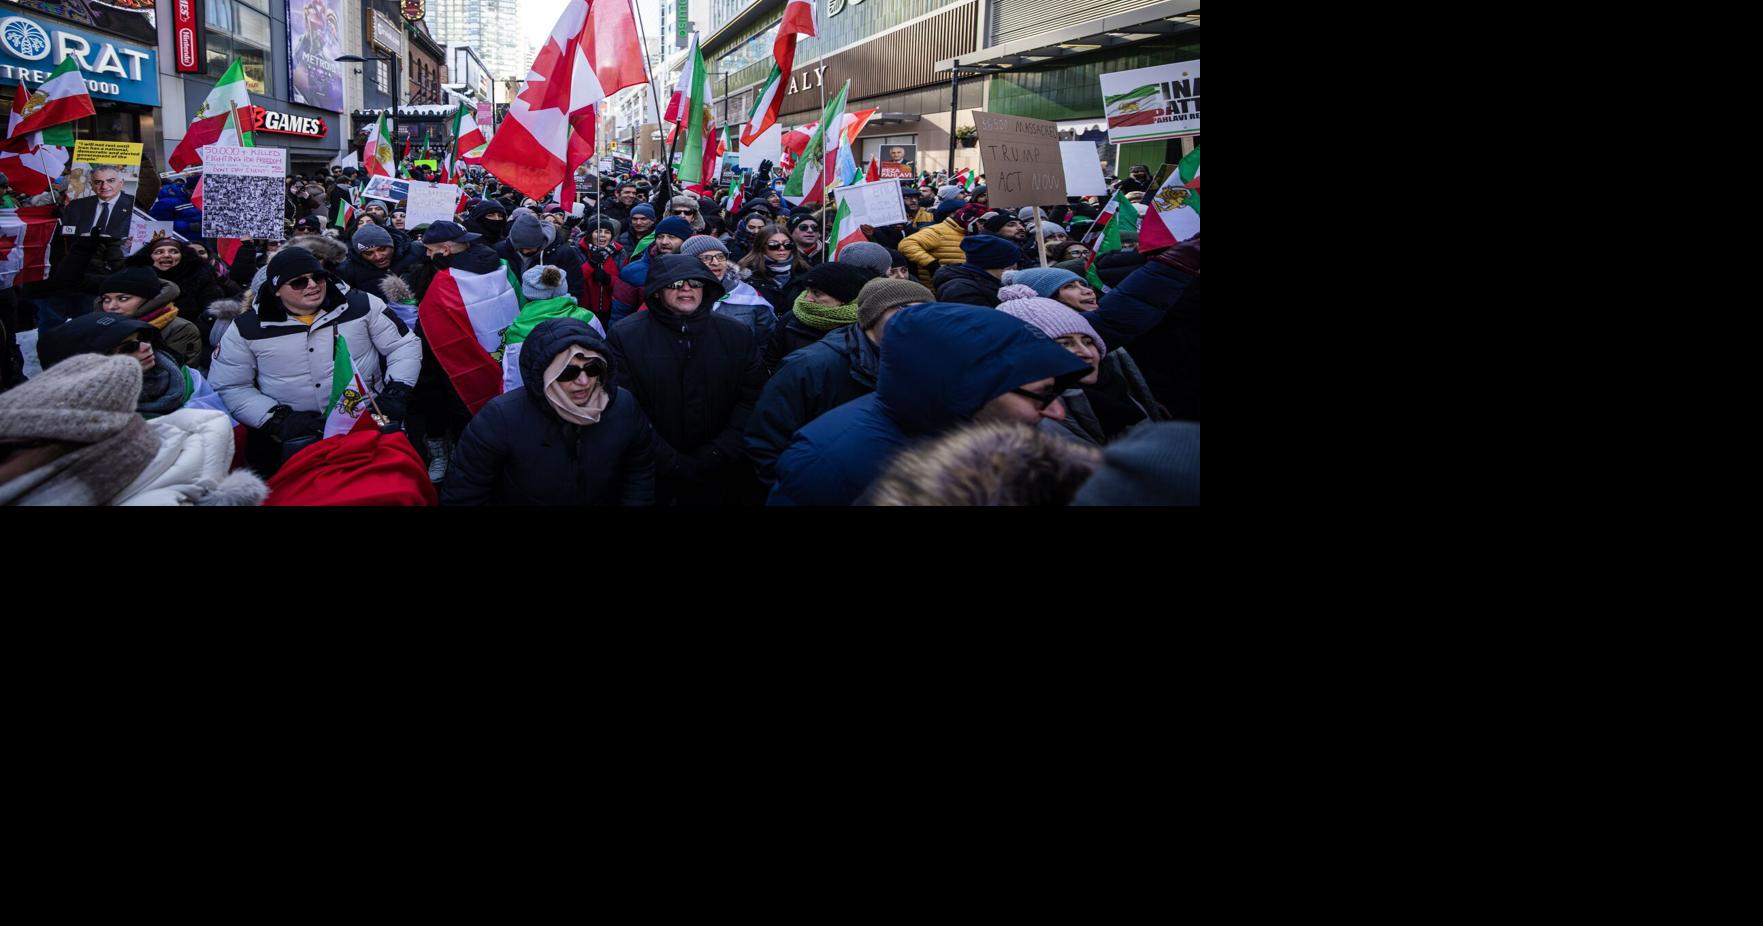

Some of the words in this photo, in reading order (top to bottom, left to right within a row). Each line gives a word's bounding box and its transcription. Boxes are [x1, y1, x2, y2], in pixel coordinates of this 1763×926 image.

[182, 31, 191, 63] Nintendo
[265, 110, 320, 134] GAMES
[987, 144, 1040, 162] TRUMP
[999, 172, 1023, 193] ACT
[1031, 174, 1059, 191] NOW
